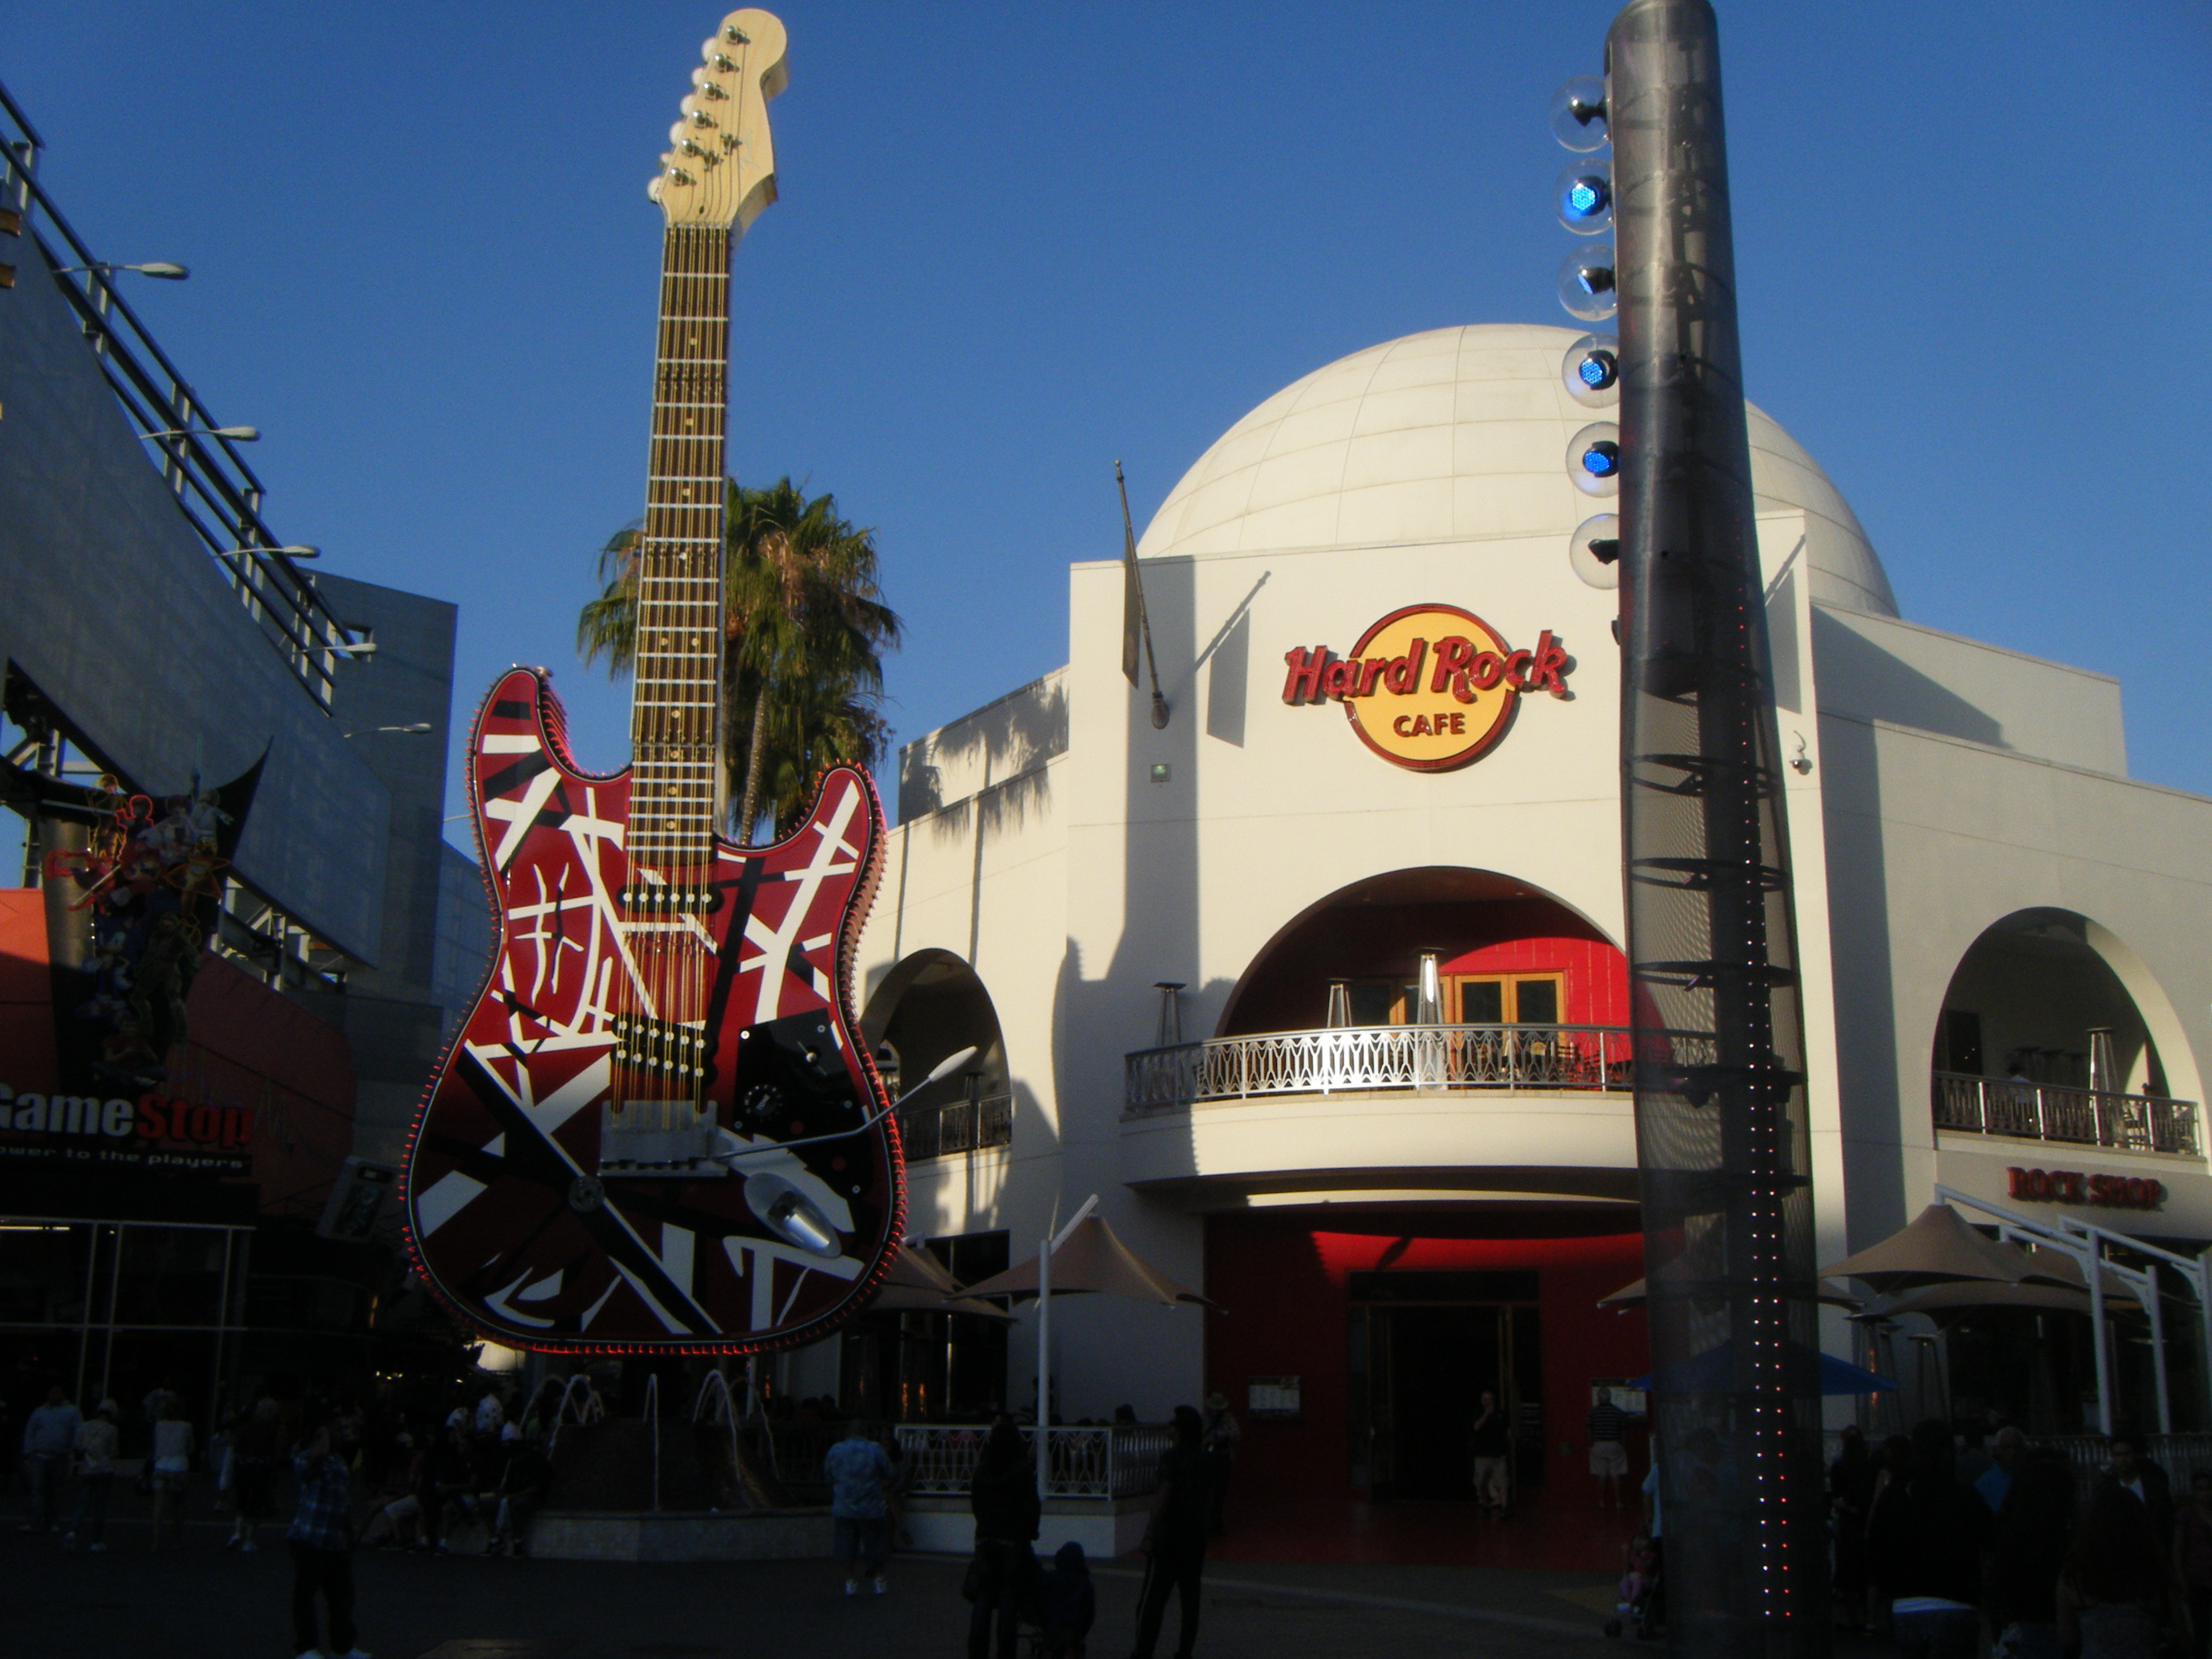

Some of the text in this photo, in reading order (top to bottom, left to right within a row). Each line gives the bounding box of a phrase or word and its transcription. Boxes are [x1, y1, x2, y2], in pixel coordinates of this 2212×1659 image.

[1283, 629, 1568, 706] Hard Rock
[1393, 712, 1465, 737] CAFE
[66, 1148, 90, 1159] to
[100, 1150, 140, 1162] the
[148, 1153, 243, 1168] players
[2007, 1166, 2163, 1210] ROCK SHOP
